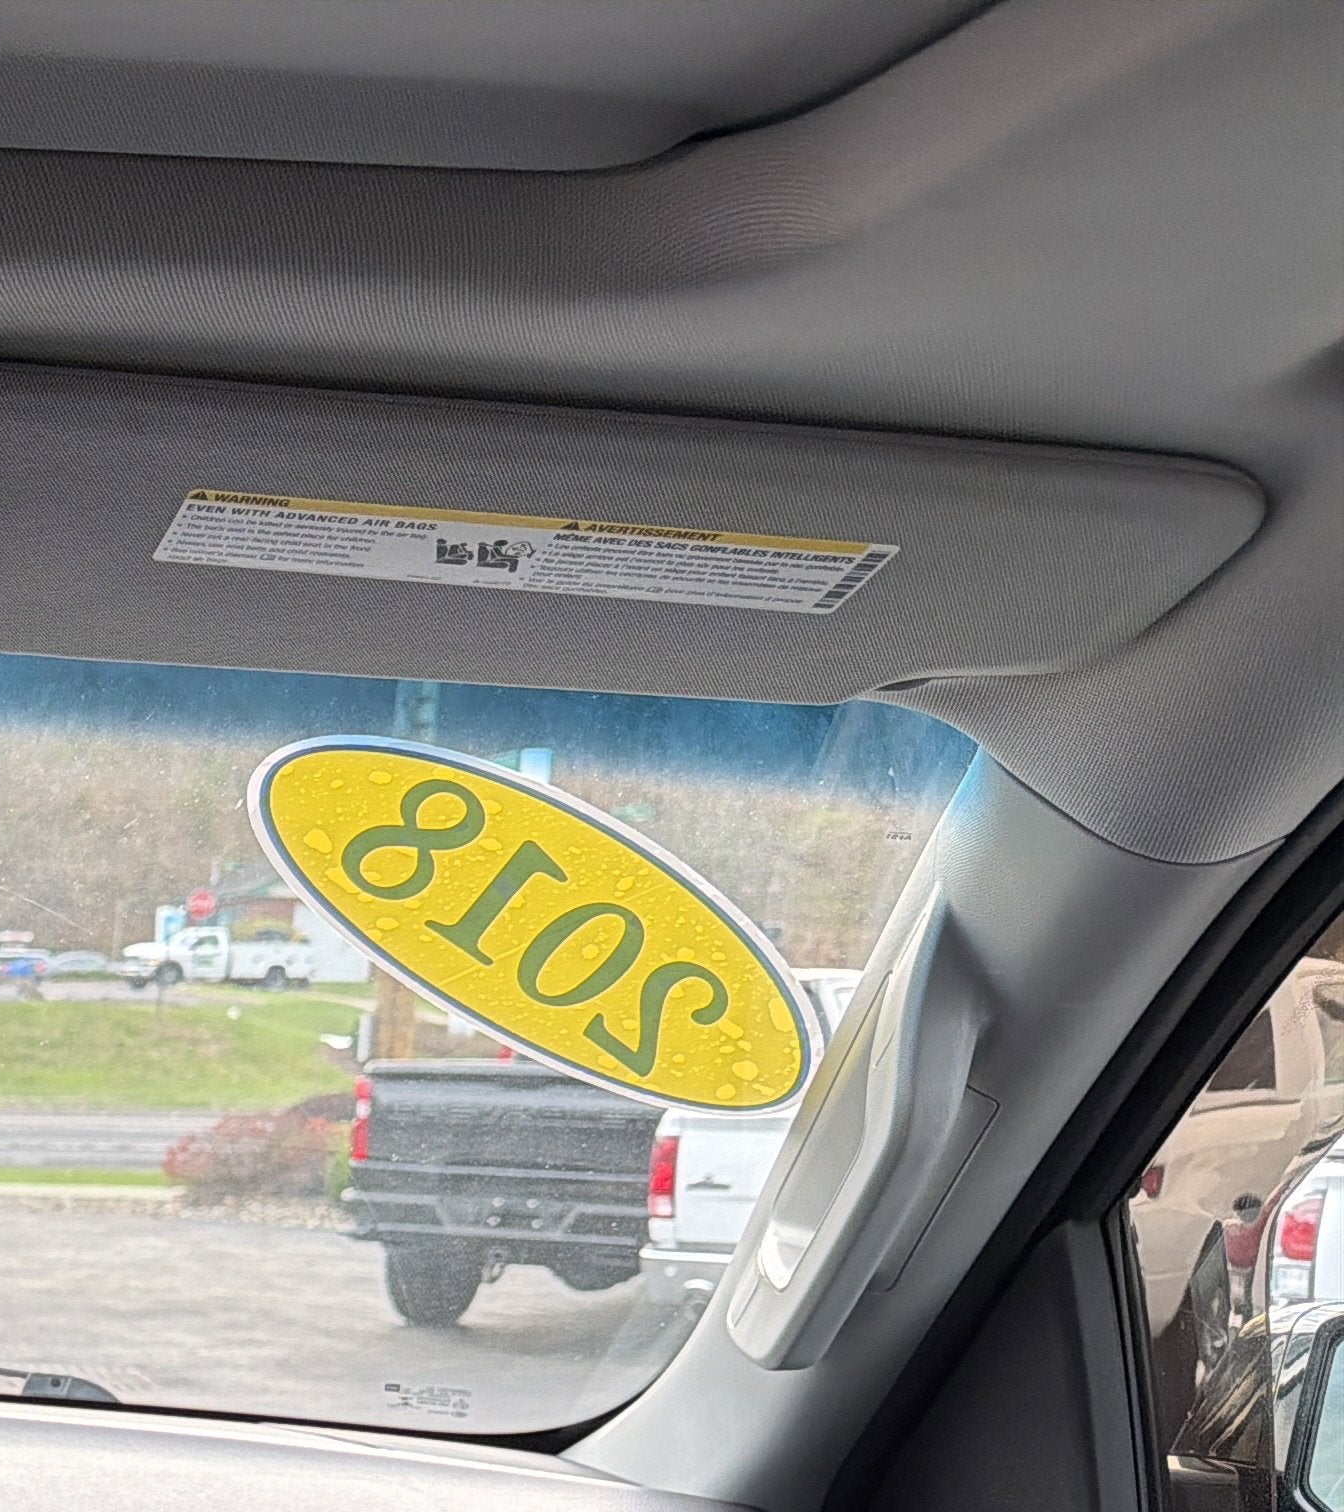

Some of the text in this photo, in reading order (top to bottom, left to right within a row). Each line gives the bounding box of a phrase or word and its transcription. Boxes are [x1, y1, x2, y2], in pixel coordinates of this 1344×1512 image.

[212, 493, 291, 508] WARNING
[185, 503, 438, 531] EVEN WITH ADVANCED AIR BAGS
[584, 523, 722, 542] AVERTISSEMENT
[592, 536, 627, 546] AVEC
[627, 538, 654, 548] DES
[654, 541, 689, 552] SACS
[691, 544, 770, 559] GONFLABLES
[770, 550, 857, 565] INTELLIGENTS
